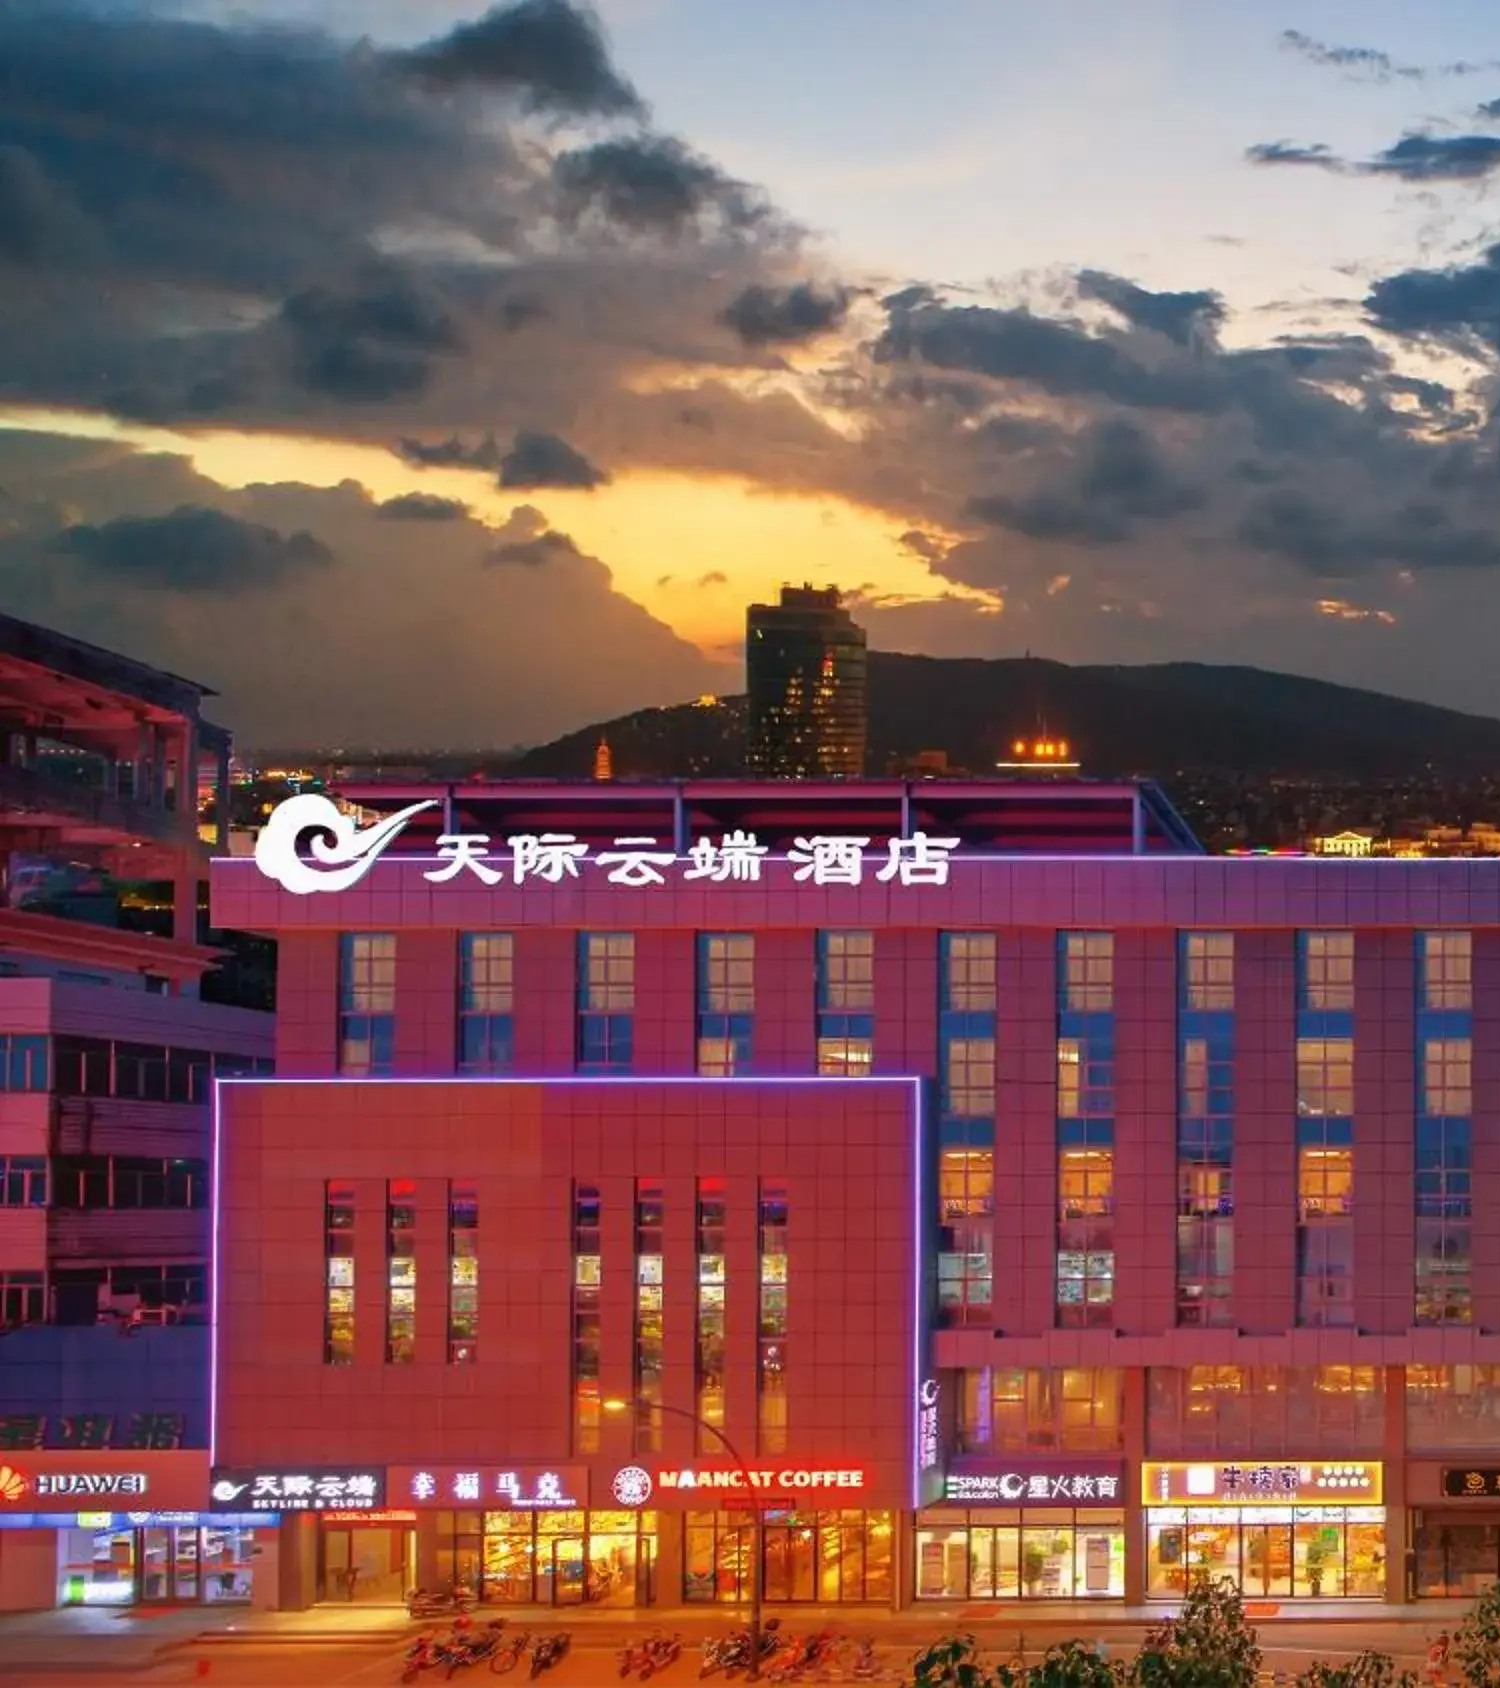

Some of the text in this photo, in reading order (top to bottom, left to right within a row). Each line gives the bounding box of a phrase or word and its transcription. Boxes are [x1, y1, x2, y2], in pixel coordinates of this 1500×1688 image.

[422, 831, 962, 887] 天际云端酒店
[36, 1472, 148, 1494] HUAWEI
[251, 1474, 377, 1497] 天际云端
[410, 1471, 561, 1500] 幸福马克
[777, 1471, 864, 1487] COFFEE
[958, 1476, 999, 1490] SPARK
[1027, 1475, 1119, 1499] 星火教育
[252, 1499, 309, 1509] SKYLINE
[329, 1499, 373, 1508] CLOUD
